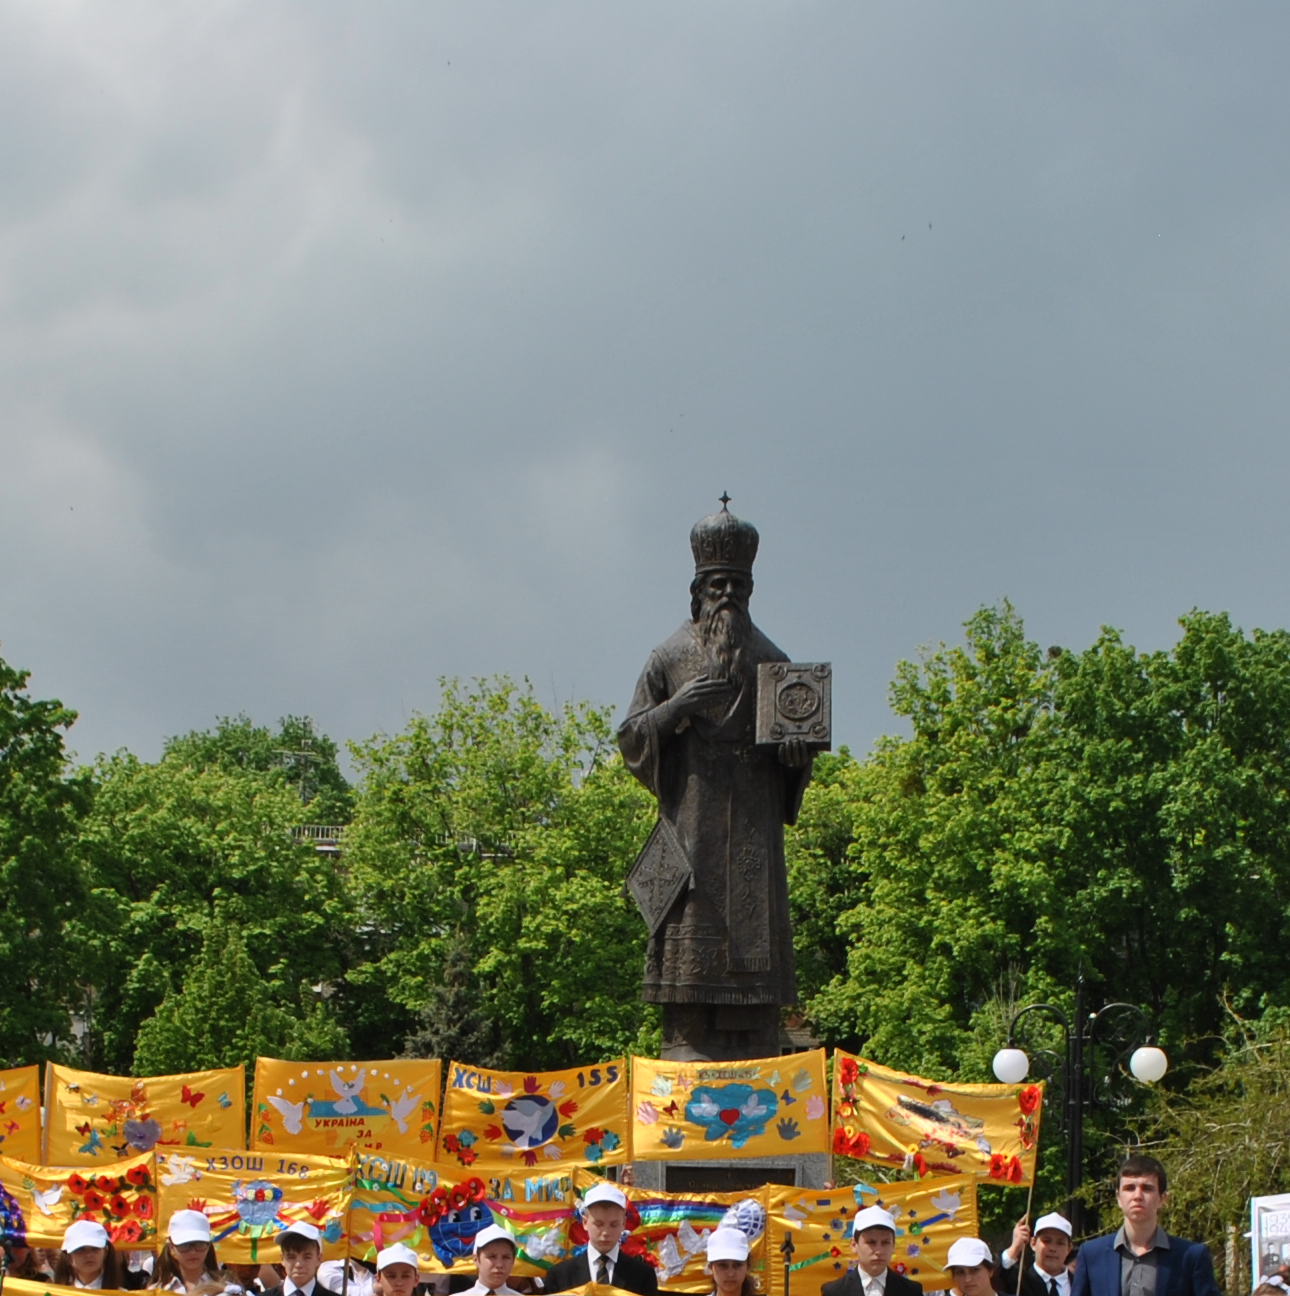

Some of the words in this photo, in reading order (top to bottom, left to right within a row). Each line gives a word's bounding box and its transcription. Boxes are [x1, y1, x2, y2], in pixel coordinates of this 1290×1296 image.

[452, 1067, 491, 1093] ХСШ
[576, 1065, 619, 1088] 155
[315, 1117, 365, 1128] УКРАЇНА
[356, 1130, 372, 1138] ЗА
[206, 1155, 263, 1171] ХЗОШ
[277, 1158, 309, 1179] 168
[487, 1178, 515, 1202] ЗА
[524, 1176, 572, 1202] МИР
